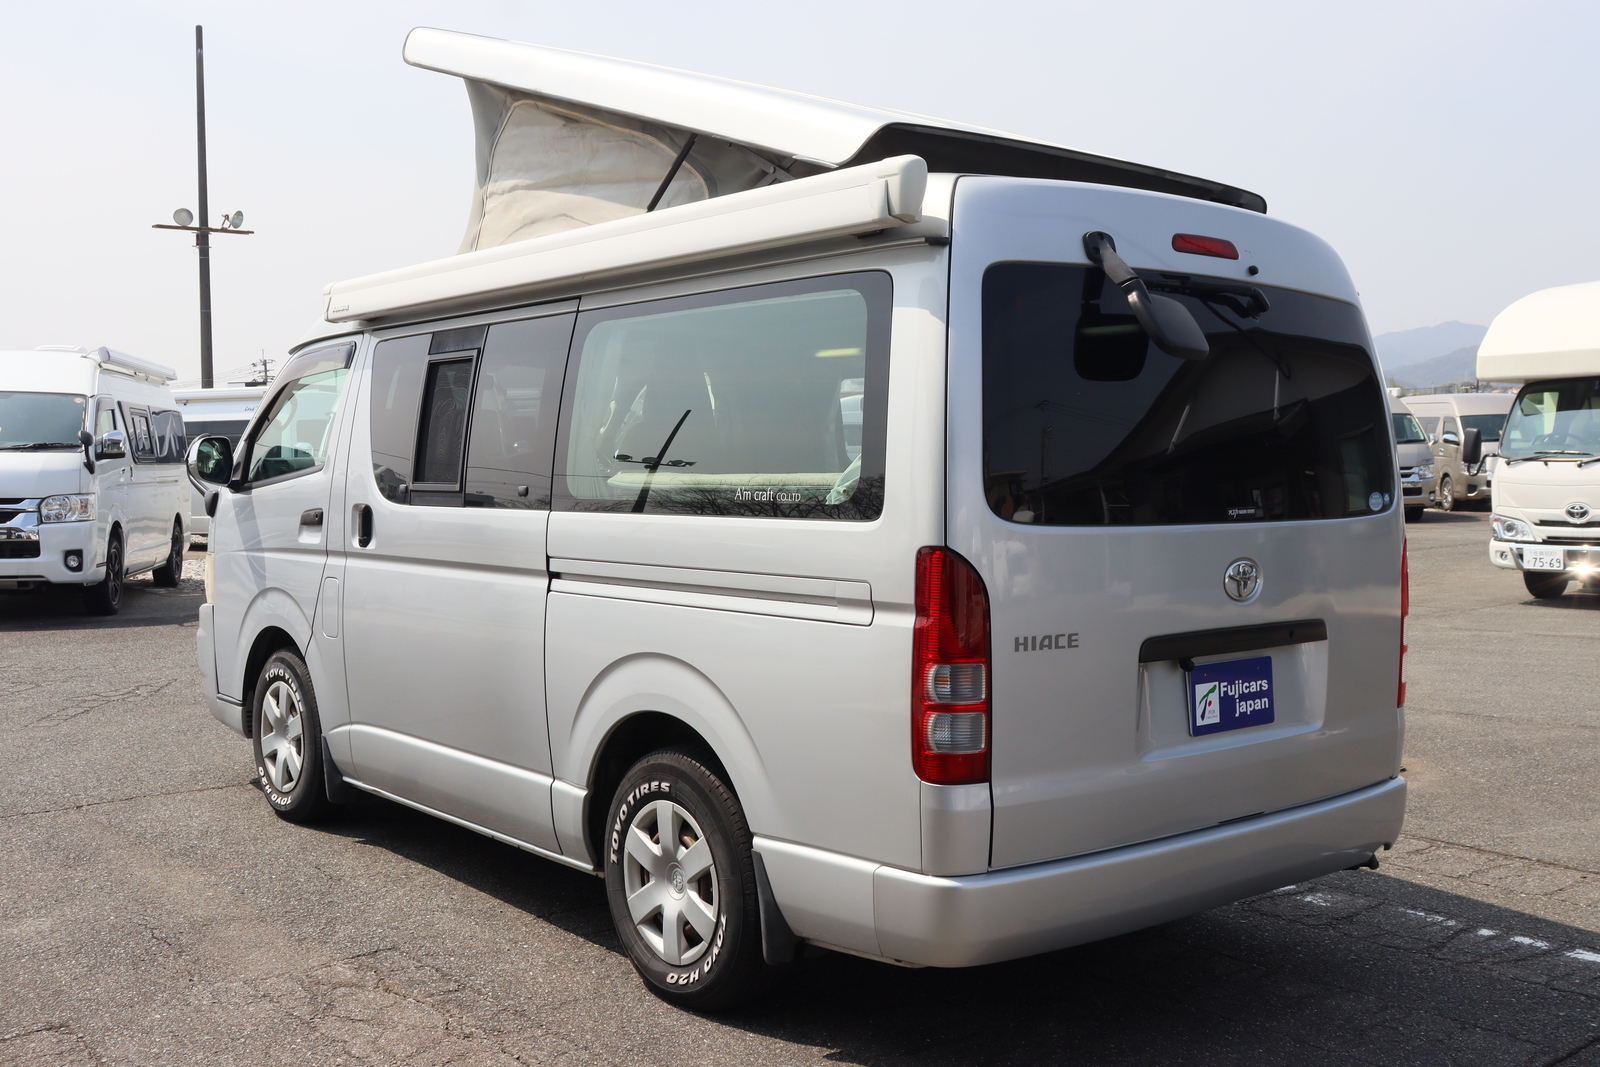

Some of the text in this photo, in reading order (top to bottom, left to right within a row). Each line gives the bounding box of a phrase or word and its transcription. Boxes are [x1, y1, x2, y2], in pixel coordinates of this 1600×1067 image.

[754, 487, 774, 502] craft
[1532, 557, 1561, 568] 75-69
[1014, 632, 1079, 653] HIACE
[264, 668, 284, 682] TOYO
[1220, 679, 1269, 699] Fujicars
[1235, 697, 1269, 717] japan
[271, 793, 292, 806] TOYO
[610, 781, 671, 865] TOYO TIRES
[703, 914, 729, 974] TOYO
